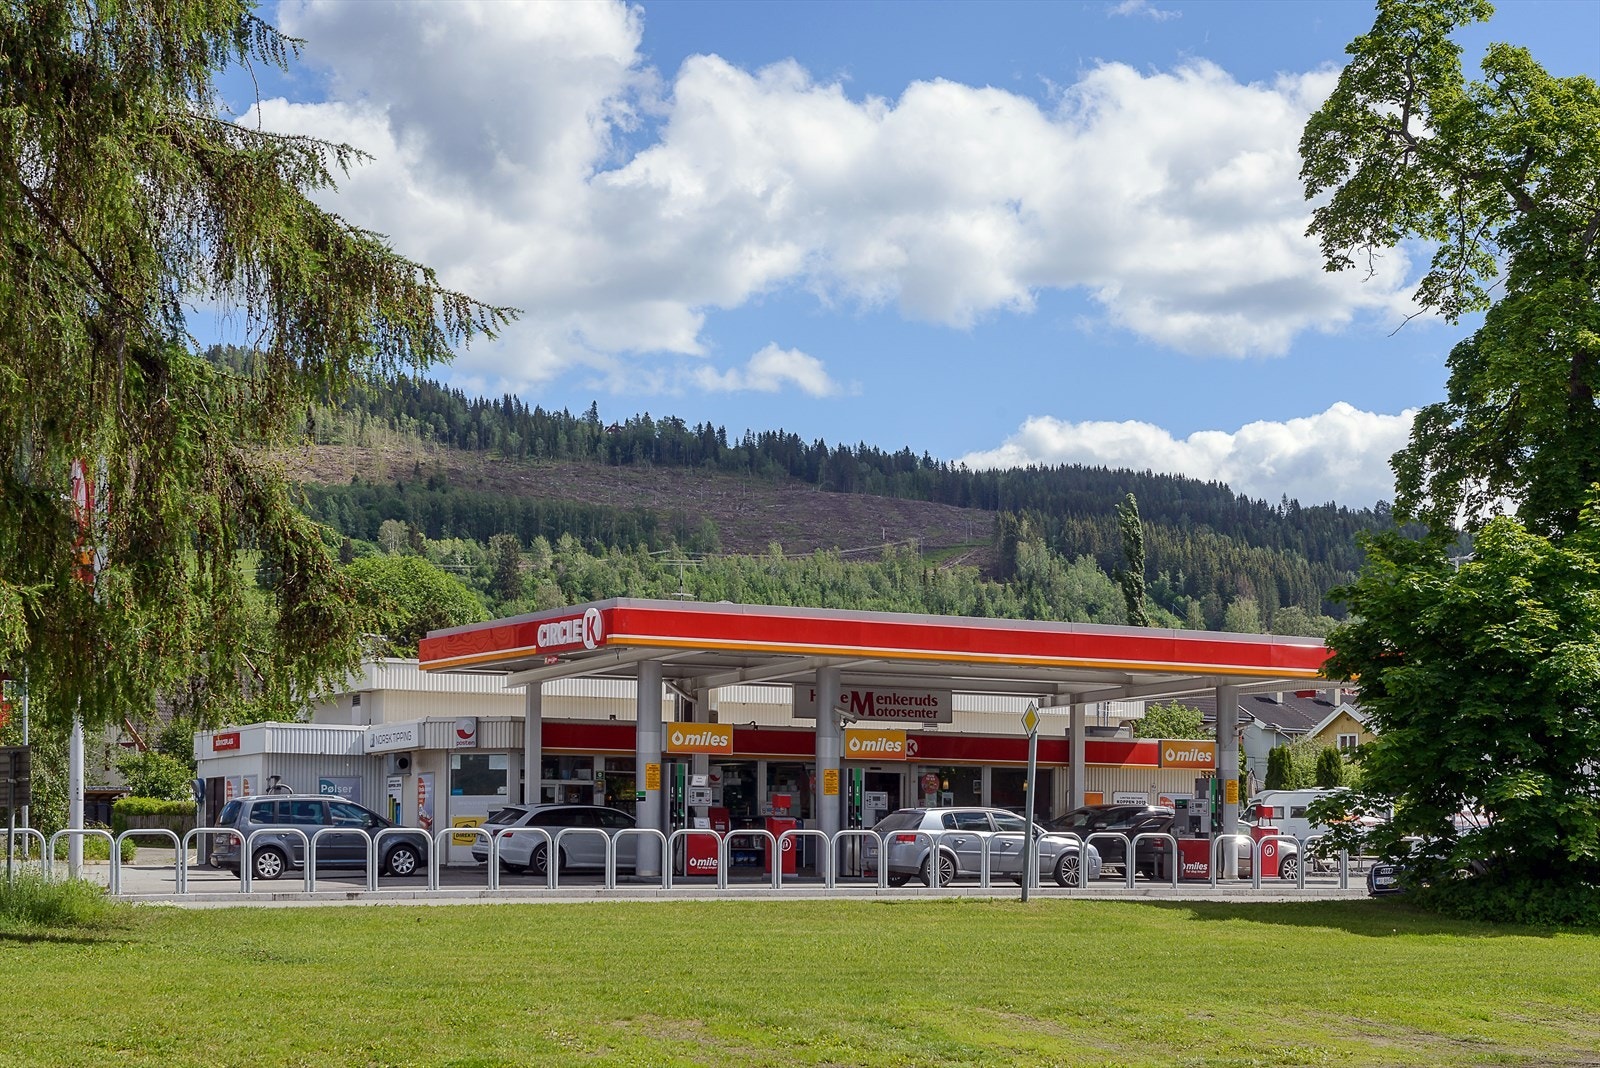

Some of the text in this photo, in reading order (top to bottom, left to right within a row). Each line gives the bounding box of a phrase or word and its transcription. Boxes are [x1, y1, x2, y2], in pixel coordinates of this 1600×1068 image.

[537, 618, 583, 648] CIRCLE
[375, 730, 412, 745] NORSK TIPPING
[684, 731, 729, 747] miles
[861, 738, 902, 752] miles
[1176, 748, 1212, 763] miles
[320, 784, 353, 793] Pølser
[697, 857, 718, 867] mile
[1186, 861, 1208, 870] miles
